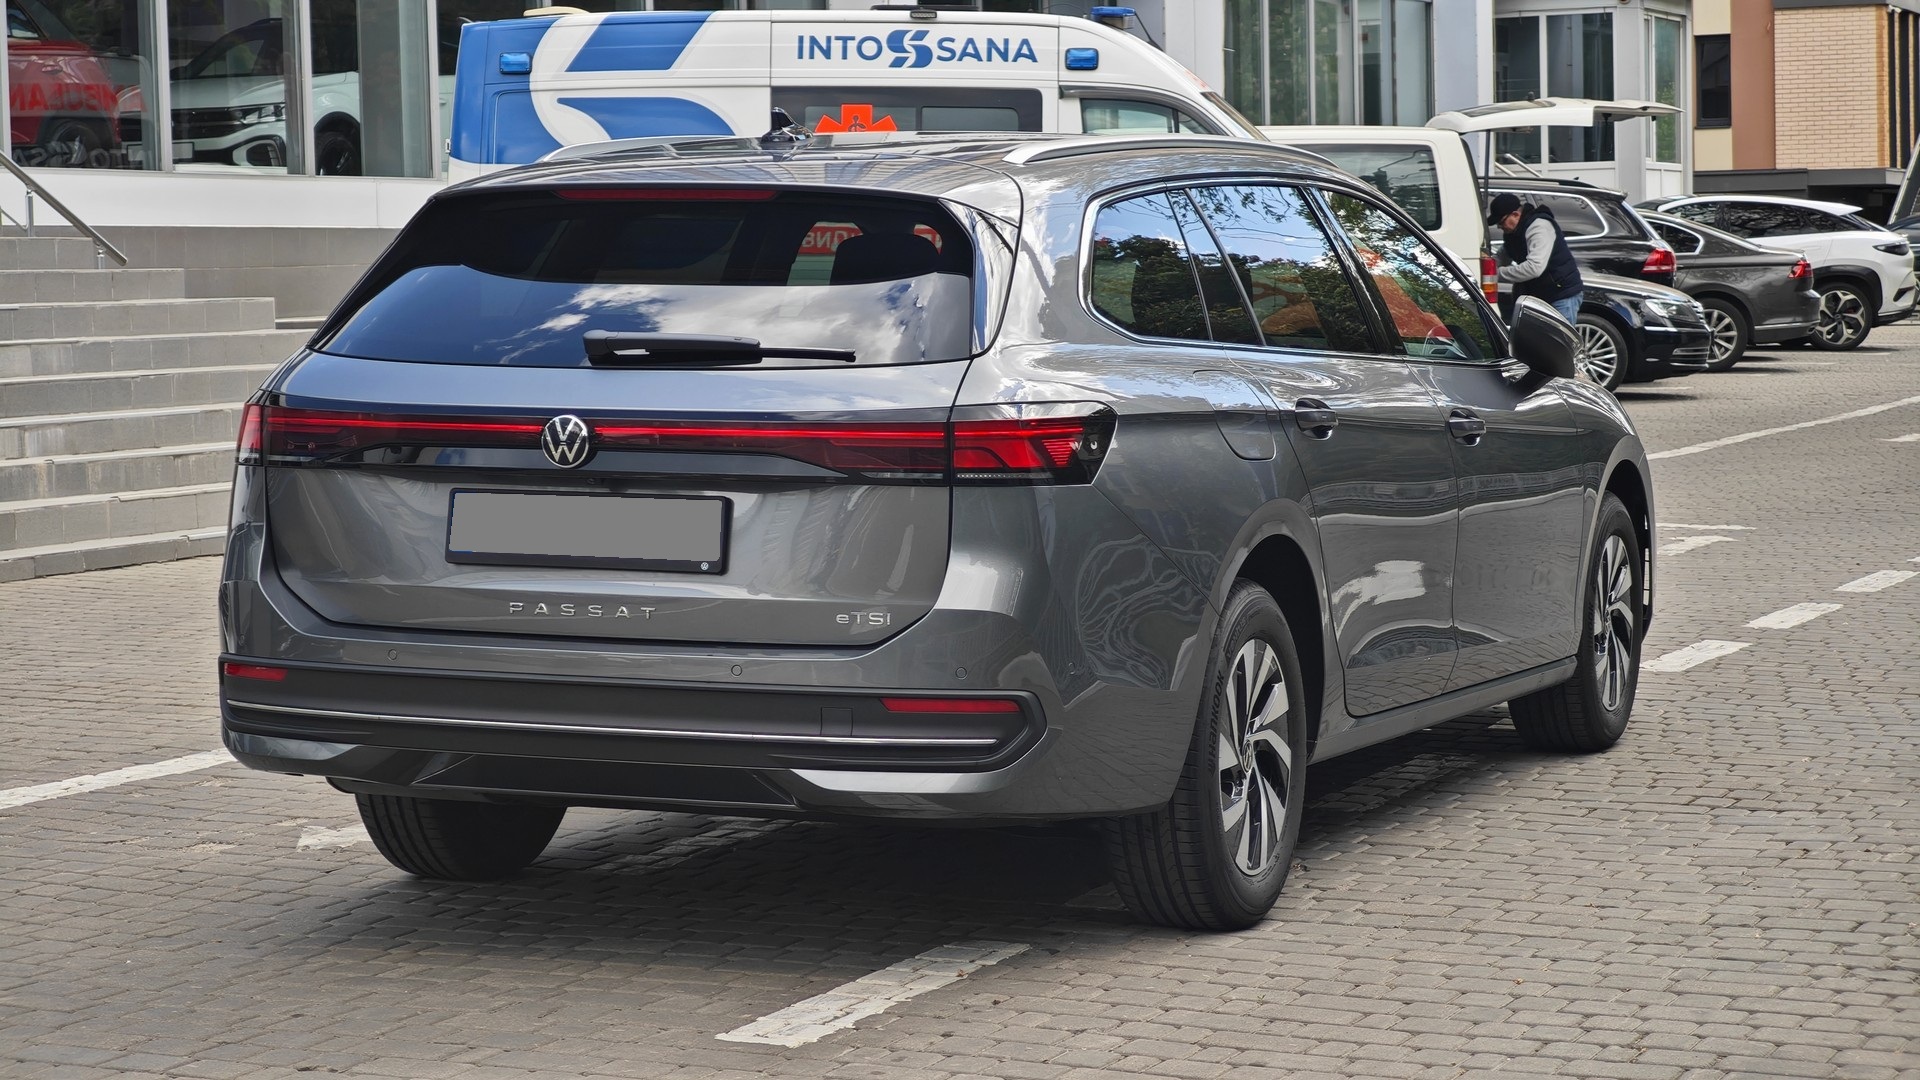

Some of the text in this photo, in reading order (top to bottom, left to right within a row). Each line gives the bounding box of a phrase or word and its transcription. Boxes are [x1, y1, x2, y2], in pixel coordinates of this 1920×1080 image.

[797, 35, 1038, 63] INTO SANA
[509, 602, 656, 620] PASSAT
[836, 611, 891, 626] eTSI
